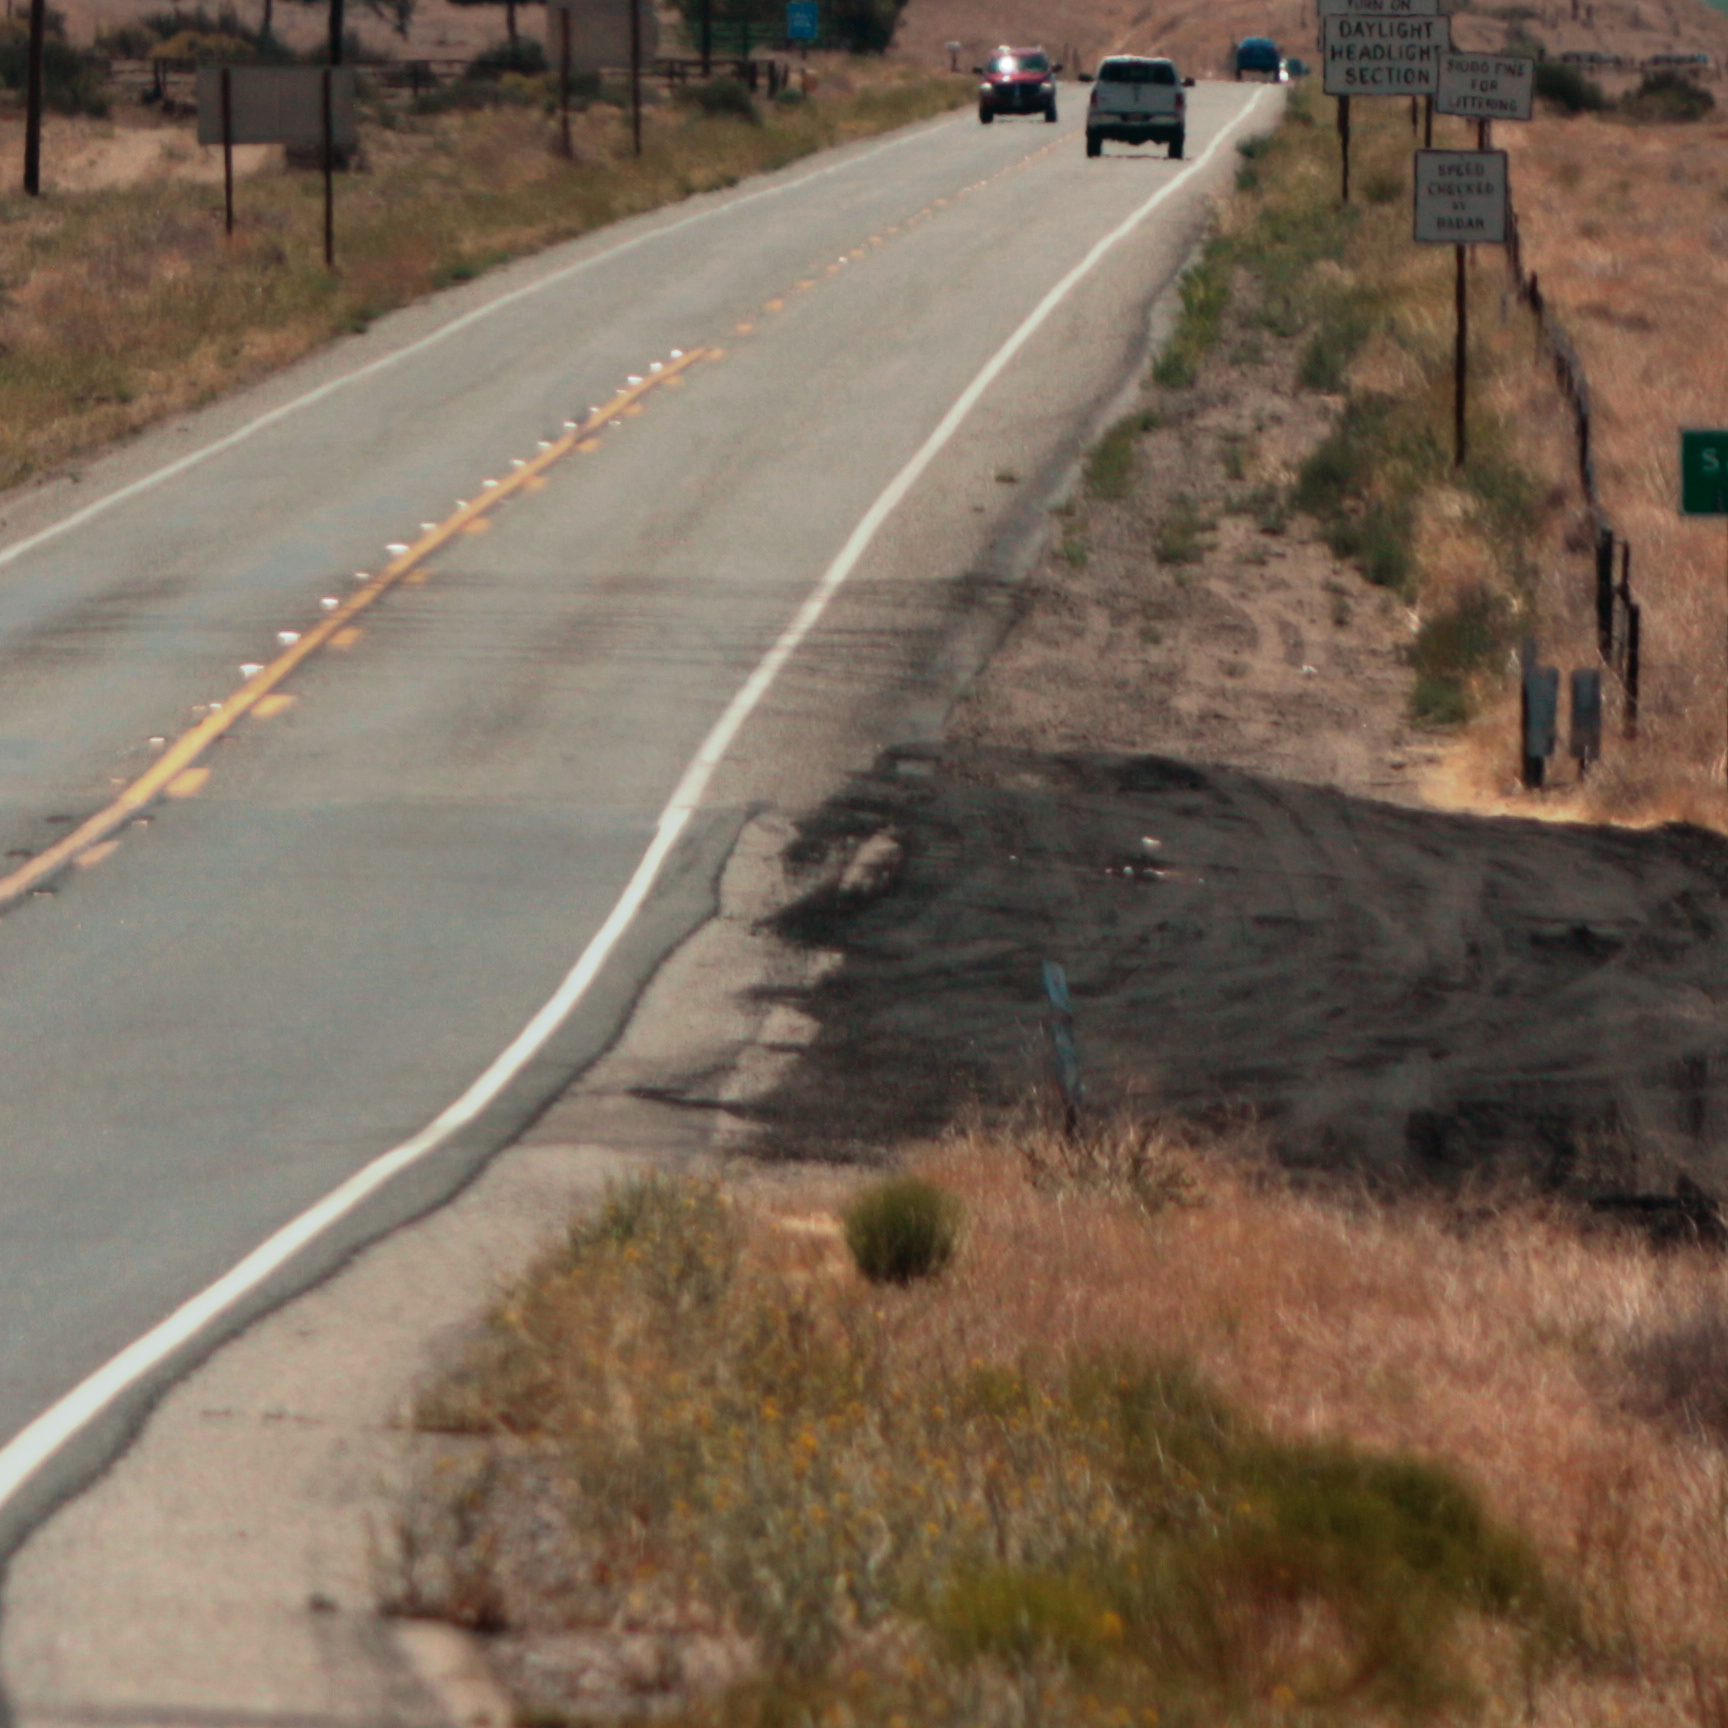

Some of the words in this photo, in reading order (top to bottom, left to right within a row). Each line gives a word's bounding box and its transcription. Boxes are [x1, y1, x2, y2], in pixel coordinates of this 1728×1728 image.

[1339, 20, 1433, 39] DAYLIGHT
[1345, 67, 1430, 85] SECTION
[1471, 79, 1498, 92] FOR
[1449, 96, 1518, 112] LITTERING
[1438, 163, 1484, 177] SPEED
[1427, 182, 1495, 196] CHECKED
[1437, 217, 1485, 230] RADAR
